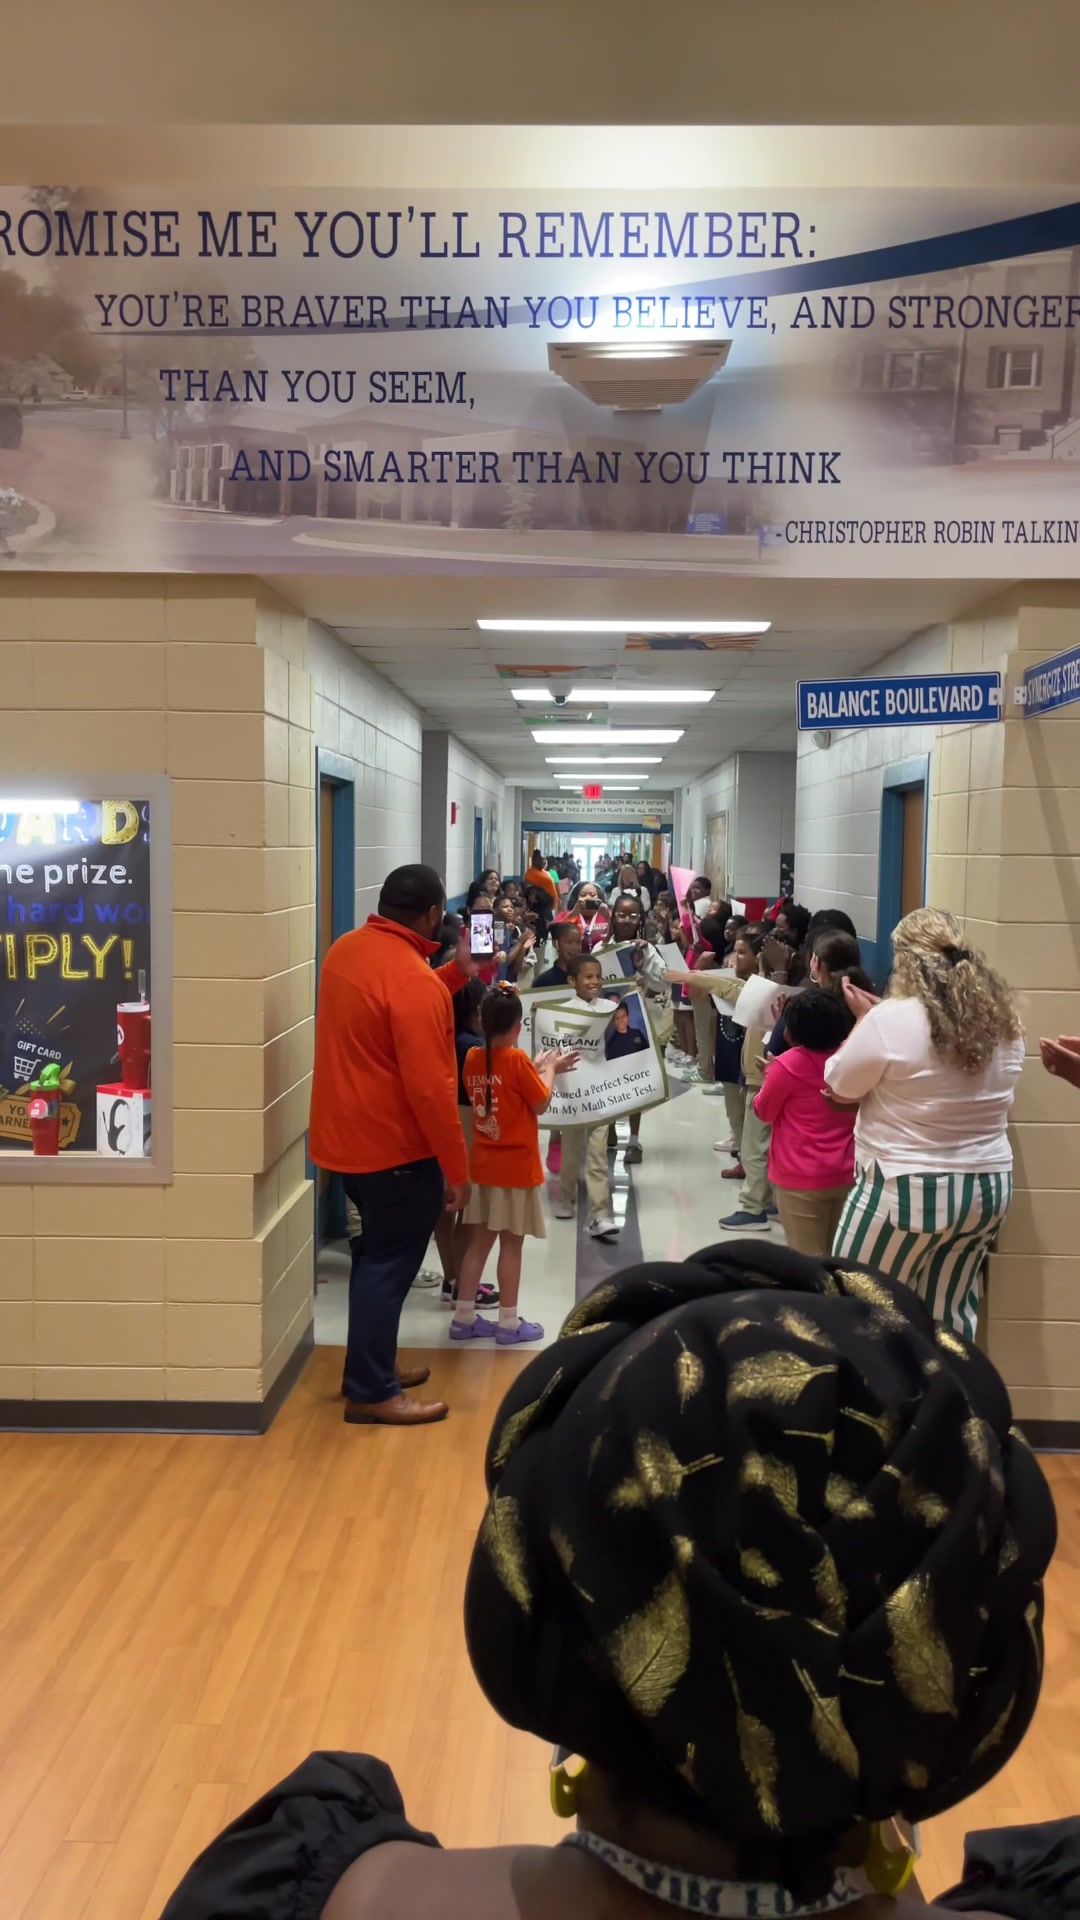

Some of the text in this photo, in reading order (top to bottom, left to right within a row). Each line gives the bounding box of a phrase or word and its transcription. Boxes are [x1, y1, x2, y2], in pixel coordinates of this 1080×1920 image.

[198, 211, 277, 257] ME
[295, 206, 480, 258] YOU'LL
[498, 211, 816, 258] REMEMBER:
[95, 291, 1080, 335] YOU'RE BRAVER THAN YOU BELIEVE, AND STRONGER
[160, 370, 475, 409] THAN YOU SEEM,
[229, 450, 841, 484] AND SMARTER THAN YOU THINK
[776, 521, 1080, 544] -CHRISTOPHER ROBIN TALKIN
[807, 685, 983, 719] BALANCE BOULEVARD
[1027, 667, 1061, 706] SYNERGIZE
[44, 857, 133, 893] prize.
[8, 896, 150, 923] hard wo
[0, 933, 134, 979] IPLY!
[17, 1040, 62, 1060] GIFT CARD
[590, 1077, 621, 1095] Perfect
[623, 1069, 650, 1084] Score
[561, 1105, 578, 1117] My
[581, 1098, 606, 1112] Math
[609, 1092, 631, 1105] State
[632, 1083, 656, 1097] Test.
